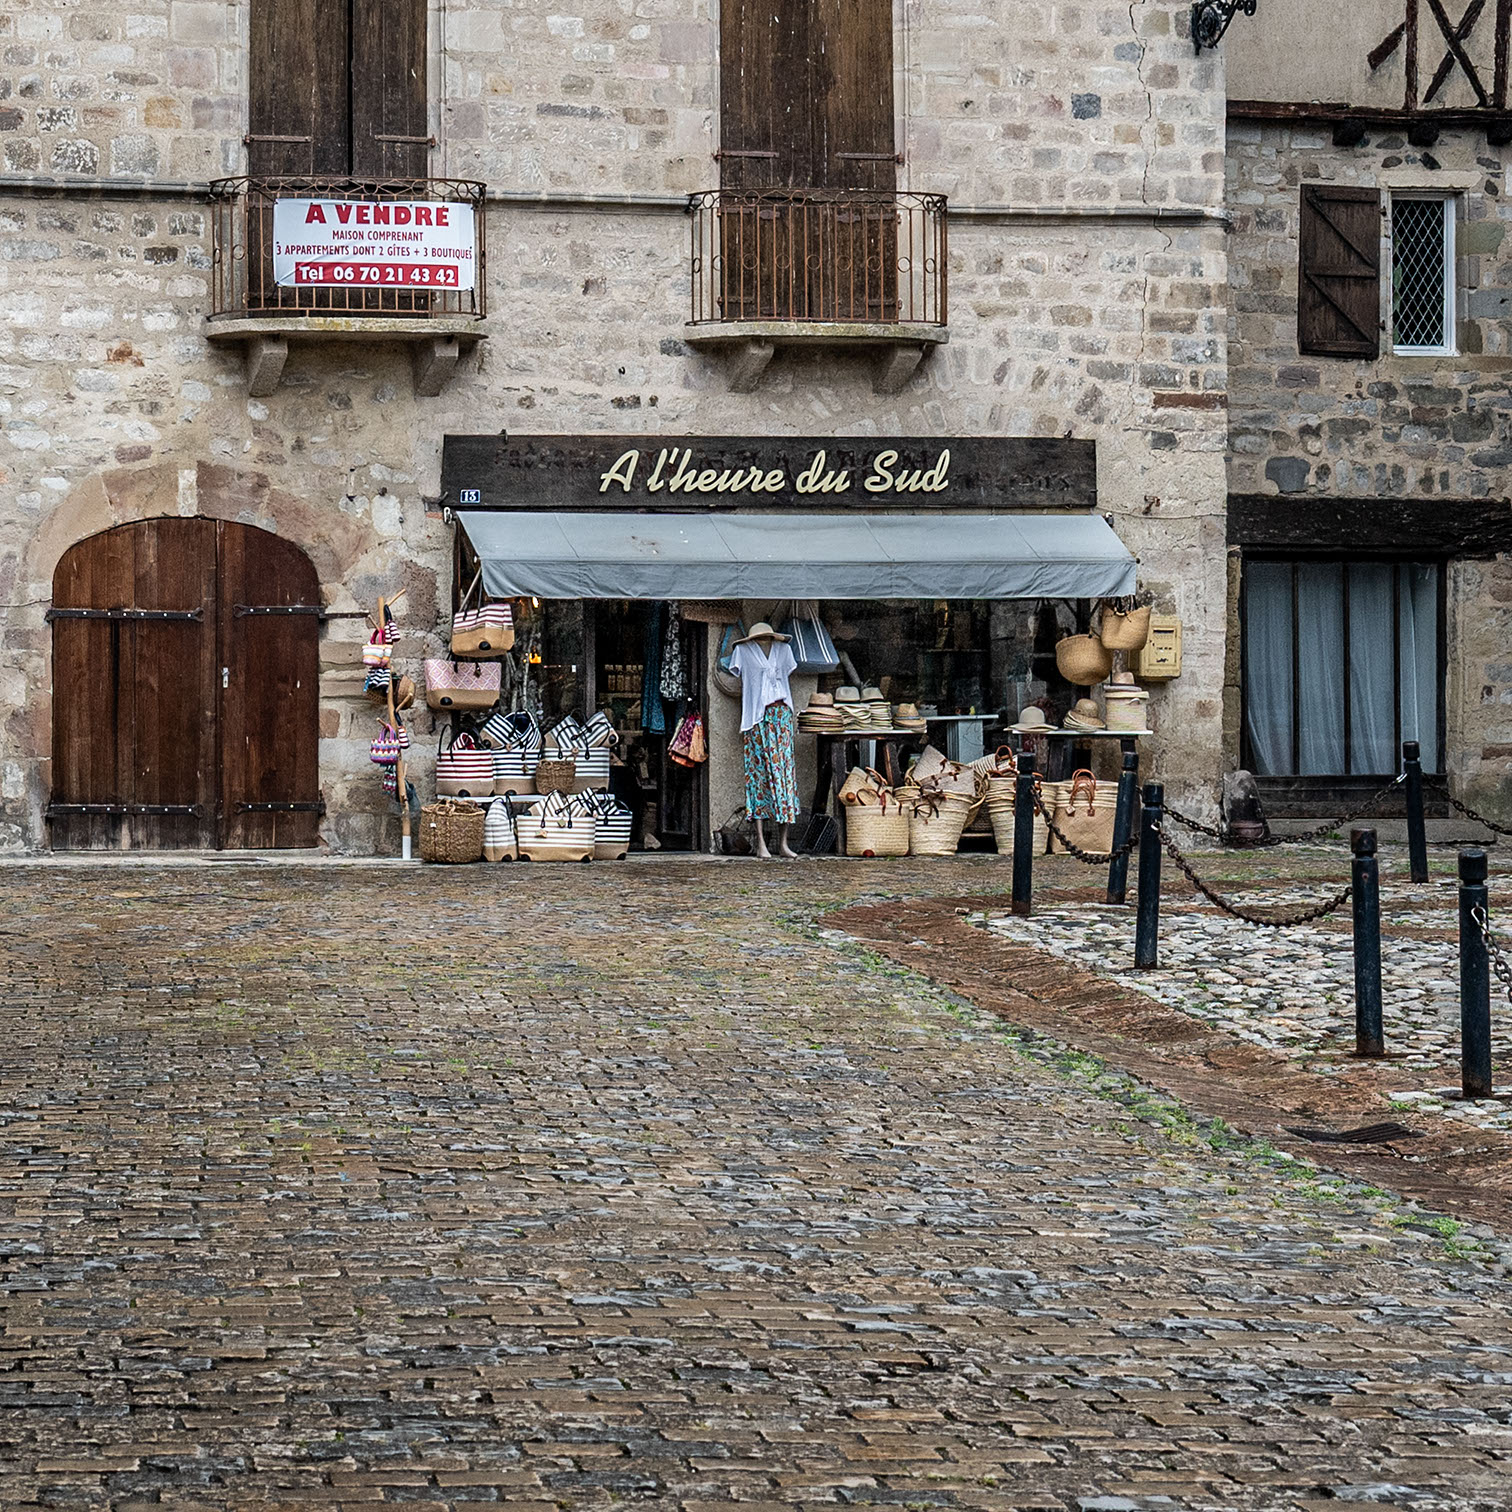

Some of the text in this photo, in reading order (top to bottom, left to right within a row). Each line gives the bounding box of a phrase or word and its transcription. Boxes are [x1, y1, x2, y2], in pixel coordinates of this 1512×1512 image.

[305, 204, 450, 227] A VENDRE
[332, 230, 424, 242] MAISON COMPRENANT
[276, 245, 282, 255] 3
[285, 245, 350, 256] APPARTEMENTS
[352, 246, 376, 256] DONT
[379, 246, 384, 256] 2
[387, 244, 411, 257] GÎTES
[423, 247, 428, 257] 3
[432, 248, 473, 260] BOUTIQUES
[299, 266, 455, 283] Tel 06 70 21 43 42
[599, 449, 640, 492] A
[647, 447, 786, 493] l'heure
[795, 449, 850, 494] du
[864, 448, 951, 493] Sud
[464, 491, 477, 502] 13
